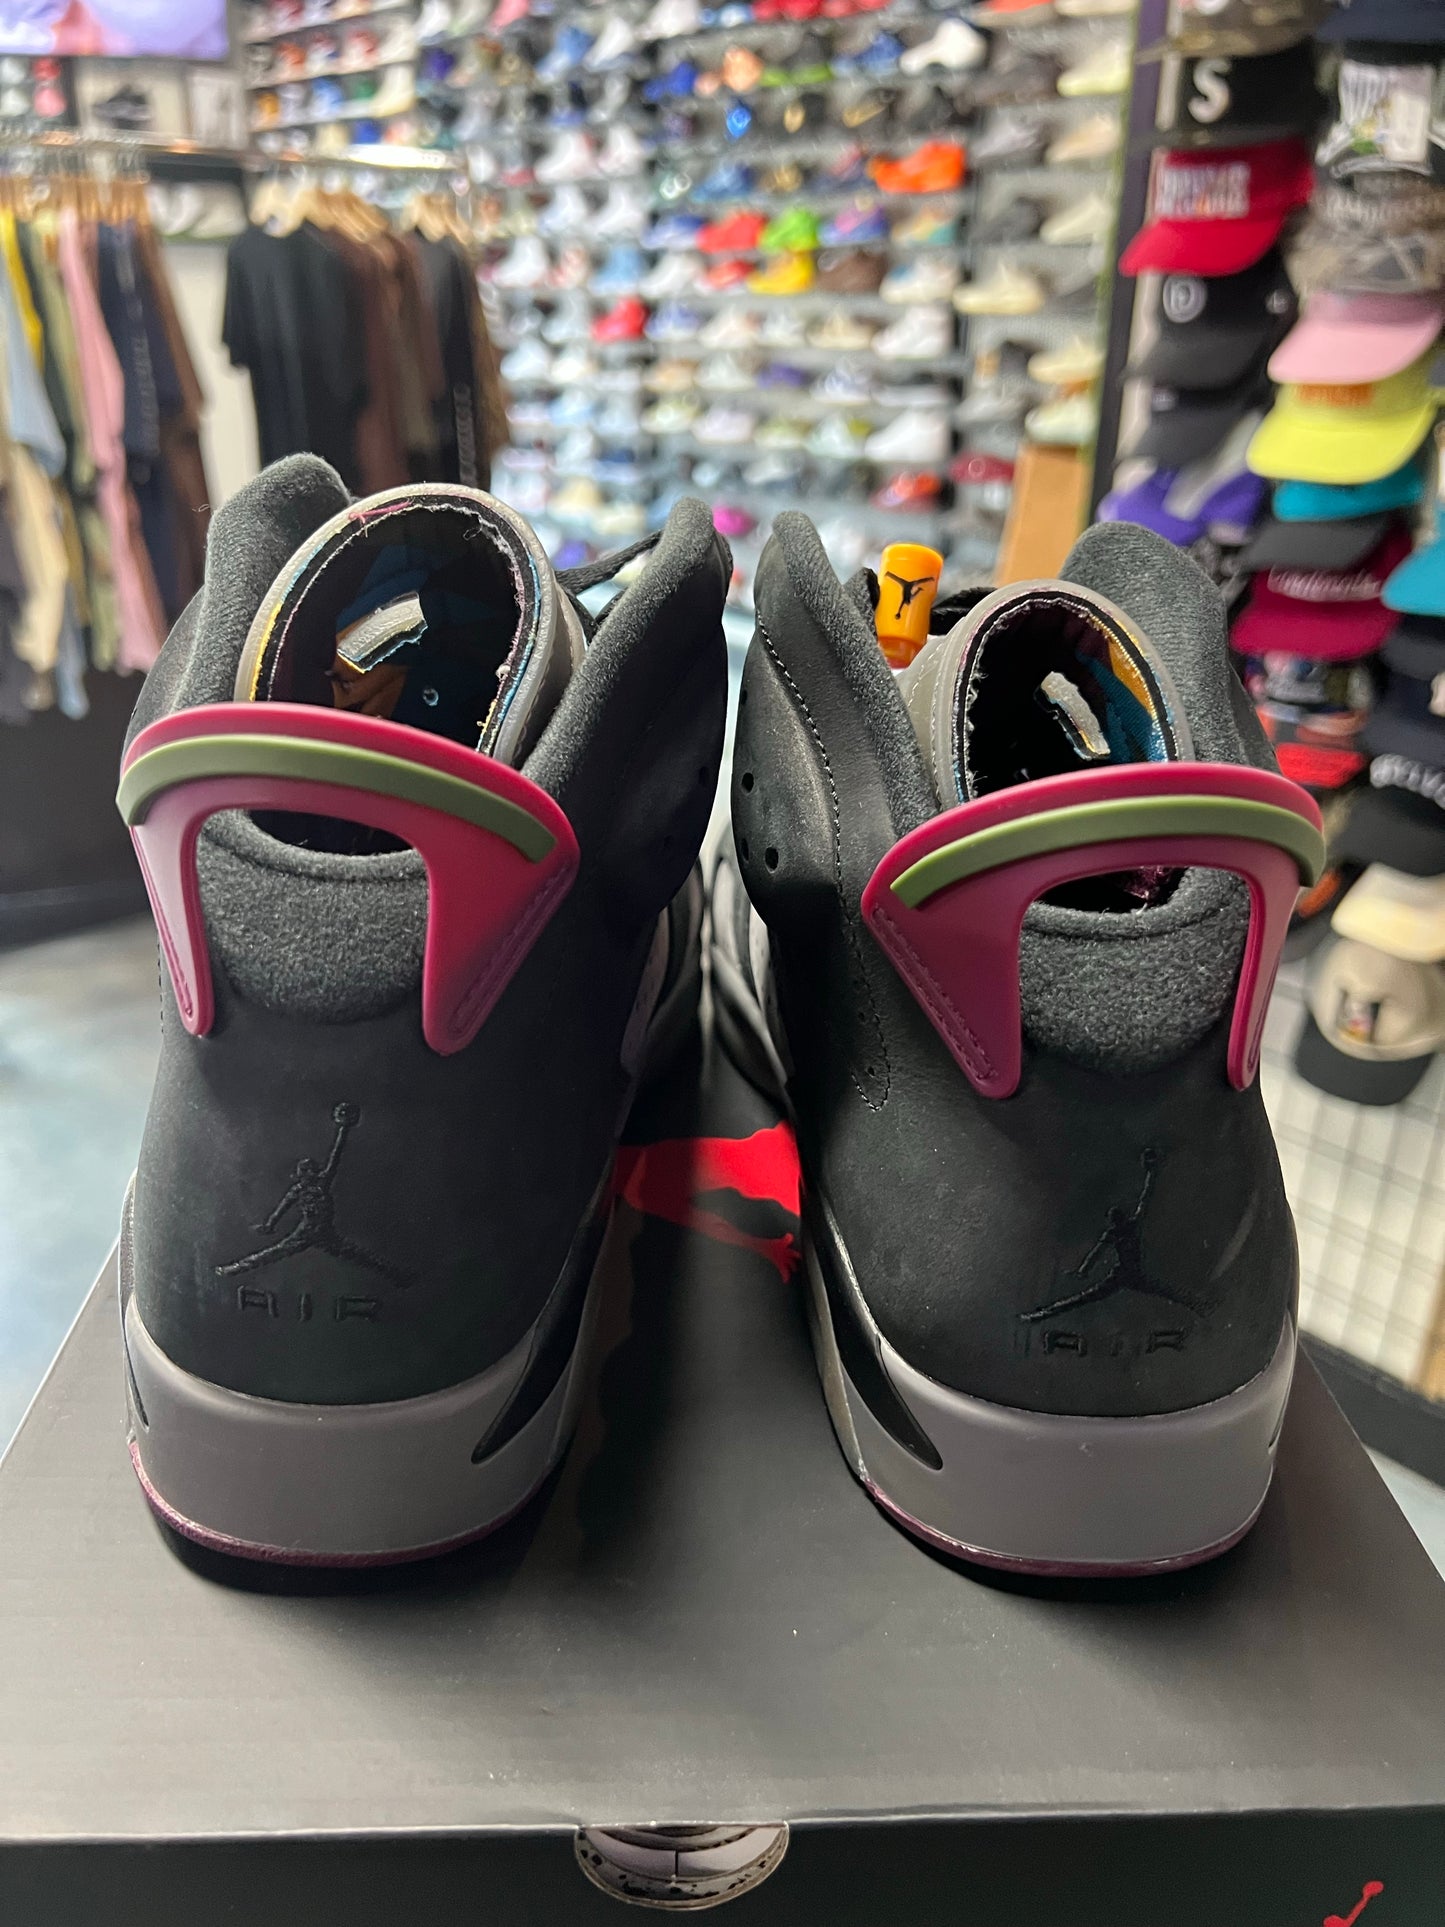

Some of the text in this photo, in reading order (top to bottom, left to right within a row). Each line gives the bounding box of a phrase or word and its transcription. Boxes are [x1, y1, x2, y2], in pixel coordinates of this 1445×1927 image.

[1188, 59, 1231, 124] S
[236, 1285, 379, 1323] AIR
[1043, 1329, 1187, 1357] AIR
